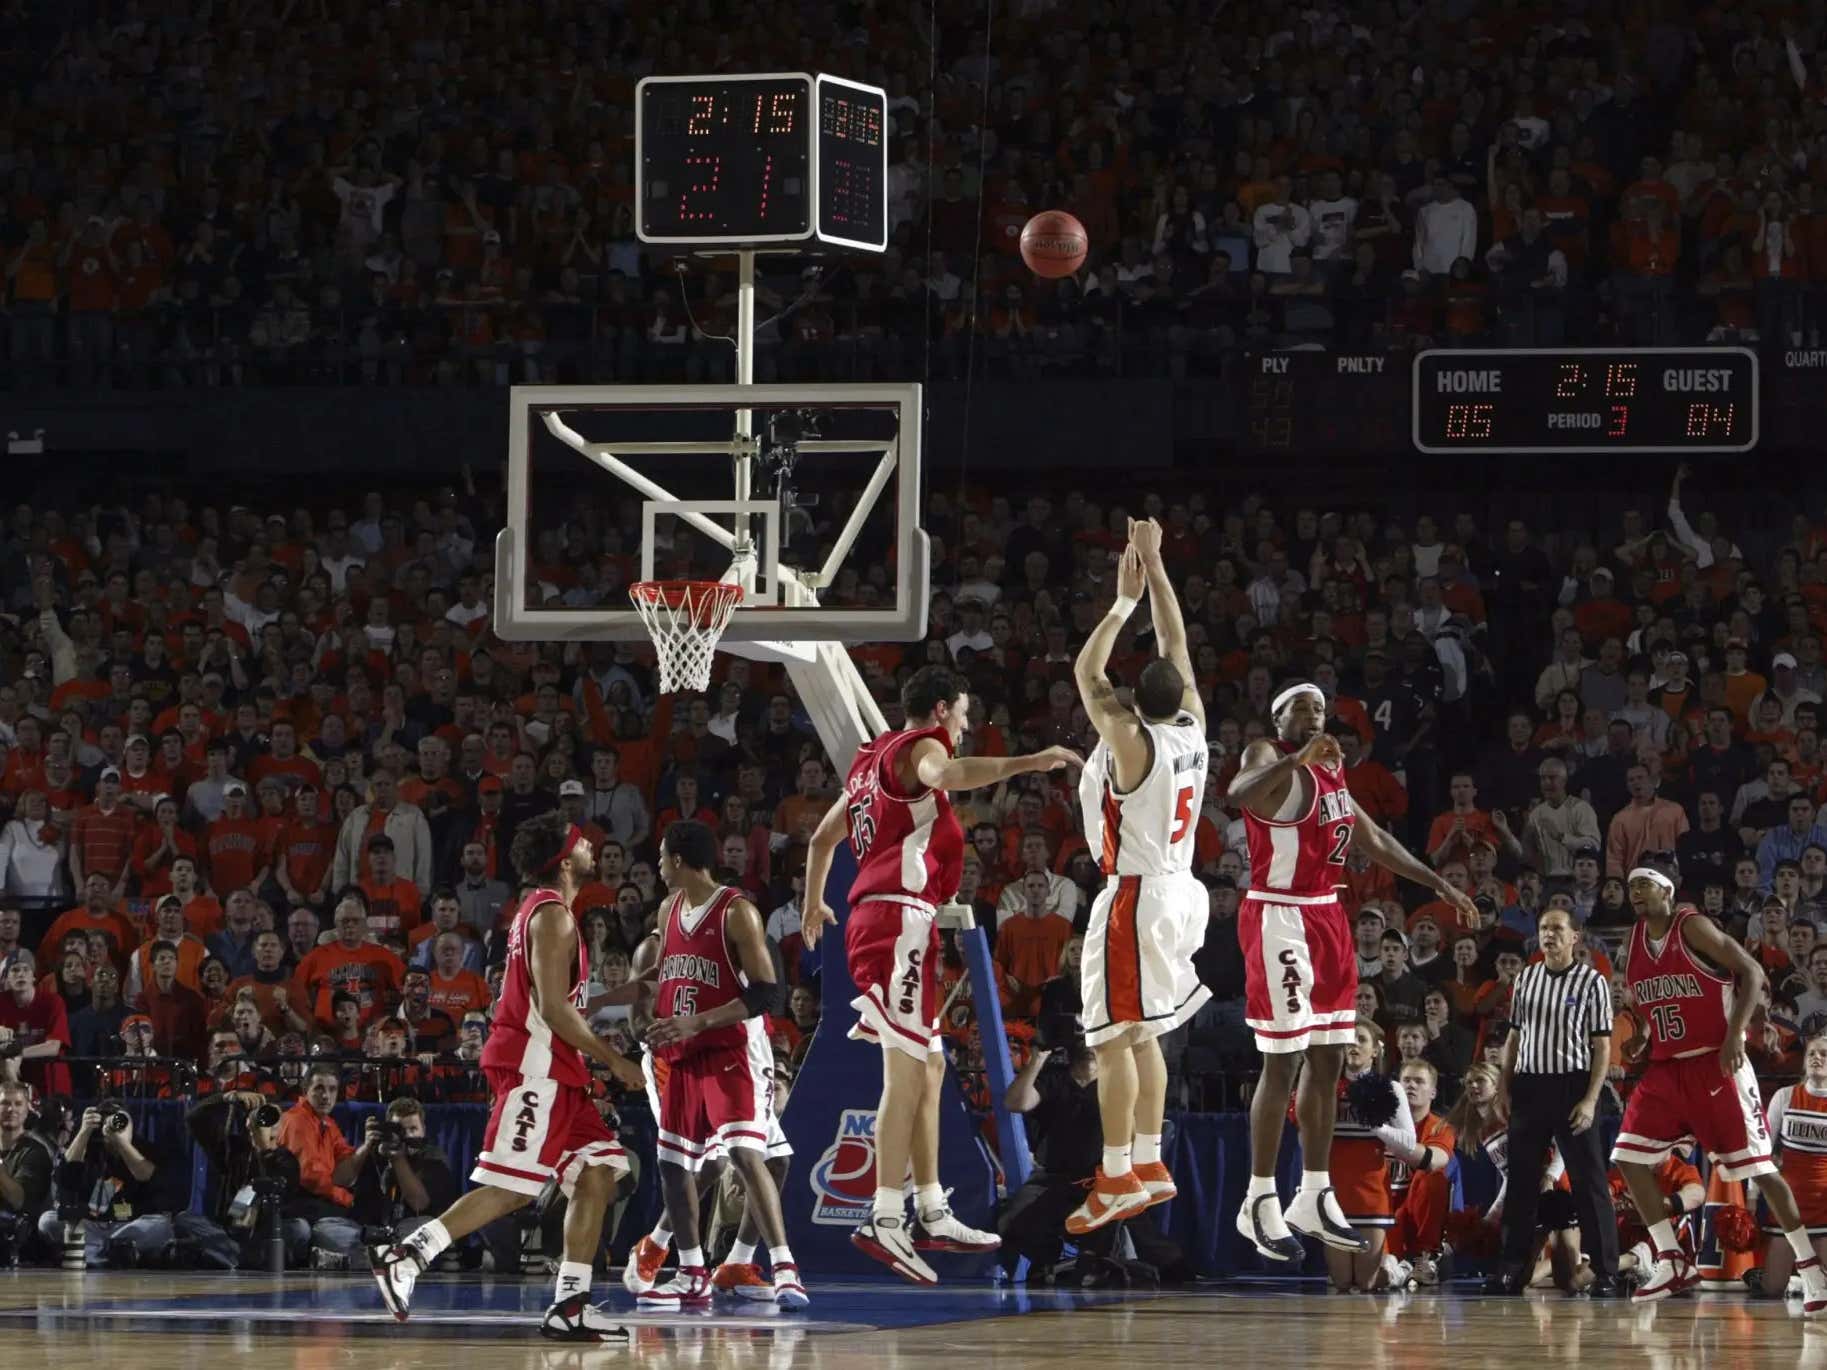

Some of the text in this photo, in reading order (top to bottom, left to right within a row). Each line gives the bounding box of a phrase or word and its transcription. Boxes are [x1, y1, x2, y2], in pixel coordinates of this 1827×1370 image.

[688, 94, 797, 135] 2:15
[679, 154, 772, 220] 21
[1262, 357, 1290, 374] PLY
[1337, 356, 1385, 374] PNLTY
[1784, 351, 1827, 368] QUART
[1436, 369, 1503, 393] HOME
[1556, 363, 1639, 397] 2:15
[1662, 368, 1735, 393] GUEST
[1447, 403, 1495, 438] 85
[1547, 405, 1631, 437] PERIOD 3
[1686, 402, 1737, 437] 84
[1169, 786, 1194, 844] 5
[658, 953, 721, 990] ARIZONA
[898, 949, 922, 1015] CATS
[1278, 949, 1302, 1014] CATS
[1632, 973, 1705, 1007] RIZONA
[1650, 1003, 1687, 1043] 15
[511, 1090, 537, 1153] CATS
